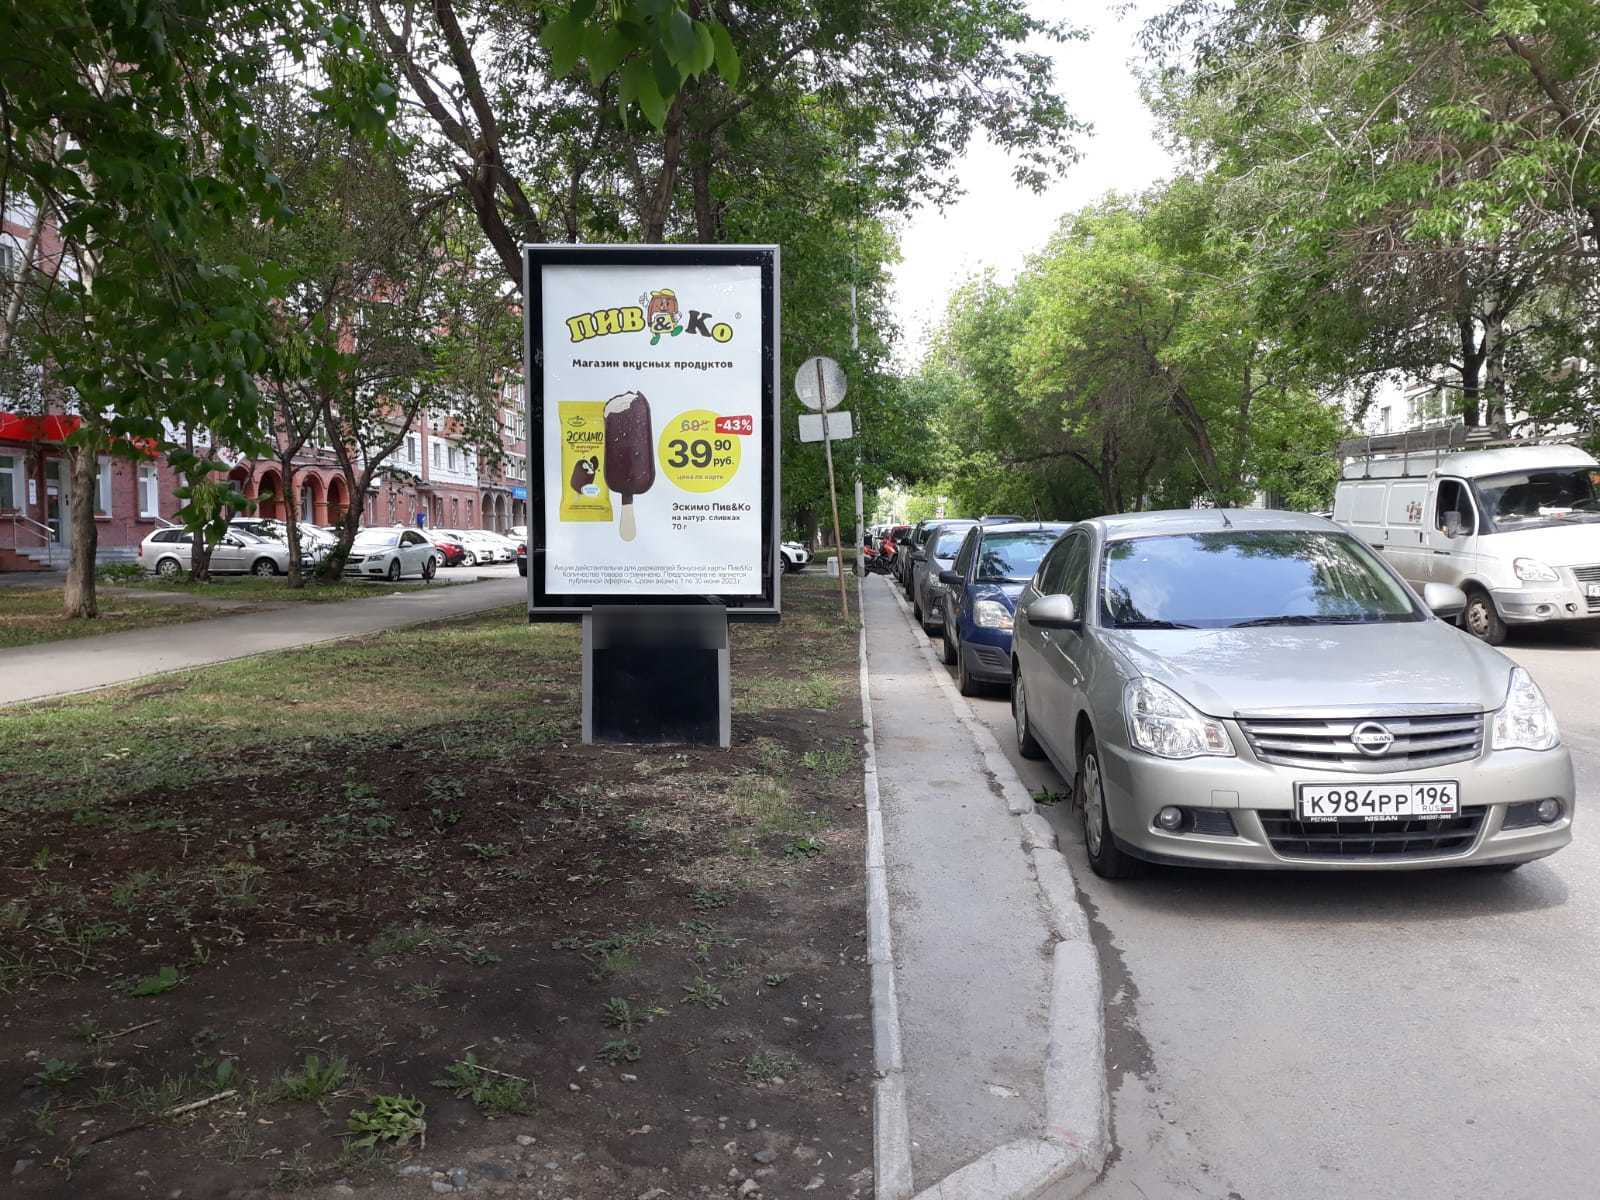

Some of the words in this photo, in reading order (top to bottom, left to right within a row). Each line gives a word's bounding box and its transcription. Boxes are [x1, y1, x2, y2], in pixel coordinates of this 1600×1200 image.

[572, 359, 619, 369] Магазин
[622, 360, 670, 371] вкусных
[674, 360, 733, 371] продуктов
[717, 419, 752, 431] -43%
[668, 439, 713, 468] 39
[714, 439, 732, 451] 90
[713, 456, 735, 467] руб.
[672, 502, 710, 511] Эскимо
[712, 502, 751, 512] Пив&Ко
[1310, 789, 1409, 814] К984РР
[1415, 787, 1451, 805] 196
